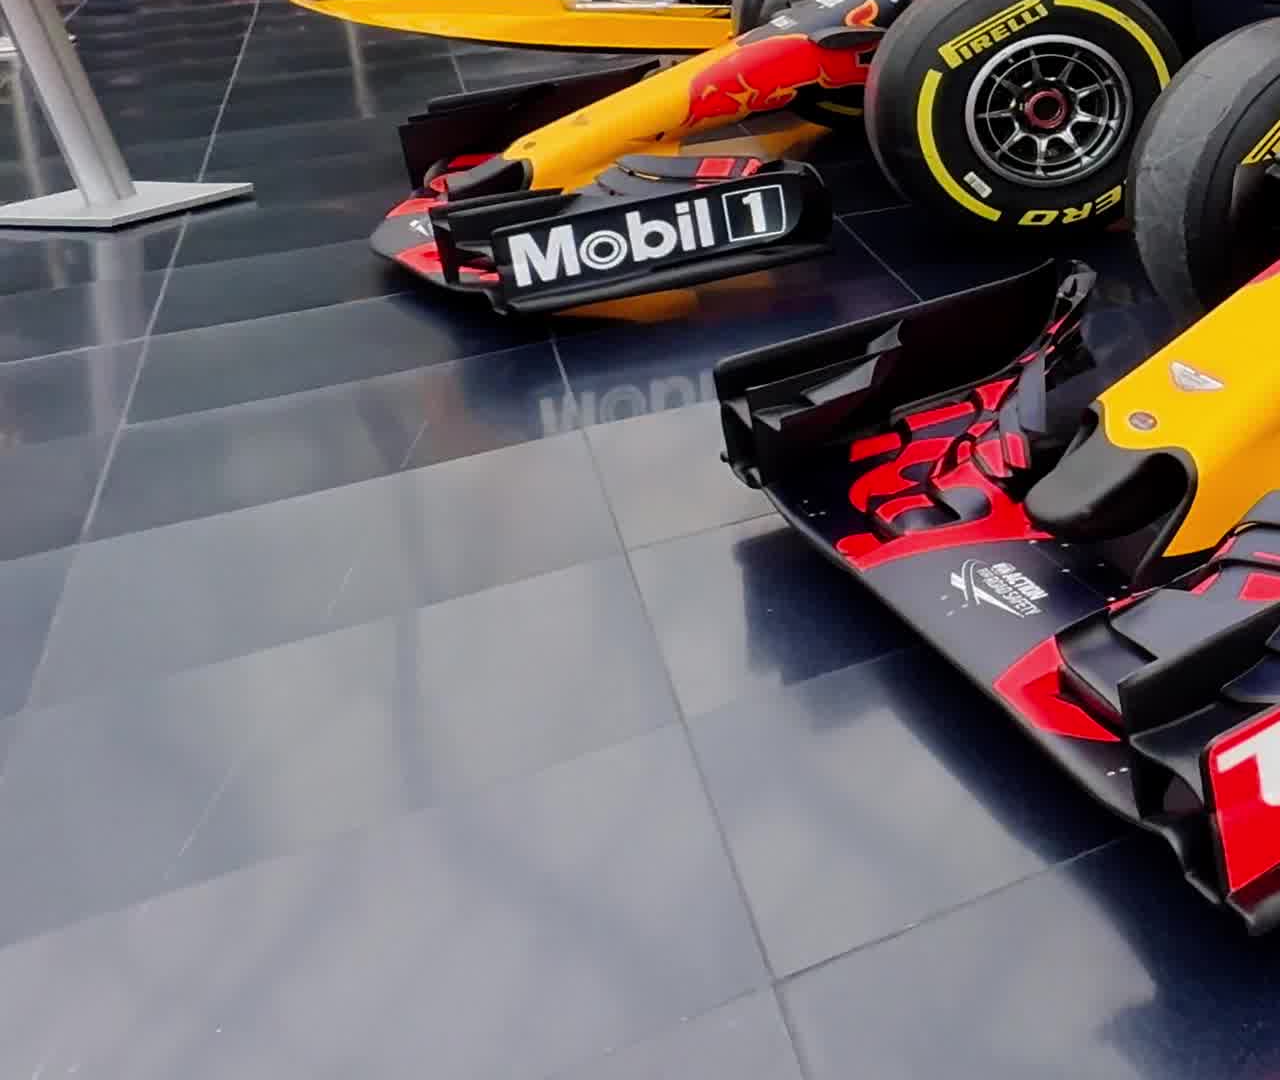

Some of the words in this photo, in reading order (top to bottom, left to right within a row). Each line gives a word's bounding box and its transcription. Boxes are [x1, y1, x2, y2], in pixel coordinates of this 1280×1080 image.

[1018, 182, 1124, 226] ERO
[507, 197, 716, 289] Mobil
[740, 191, 767, 236] 1
